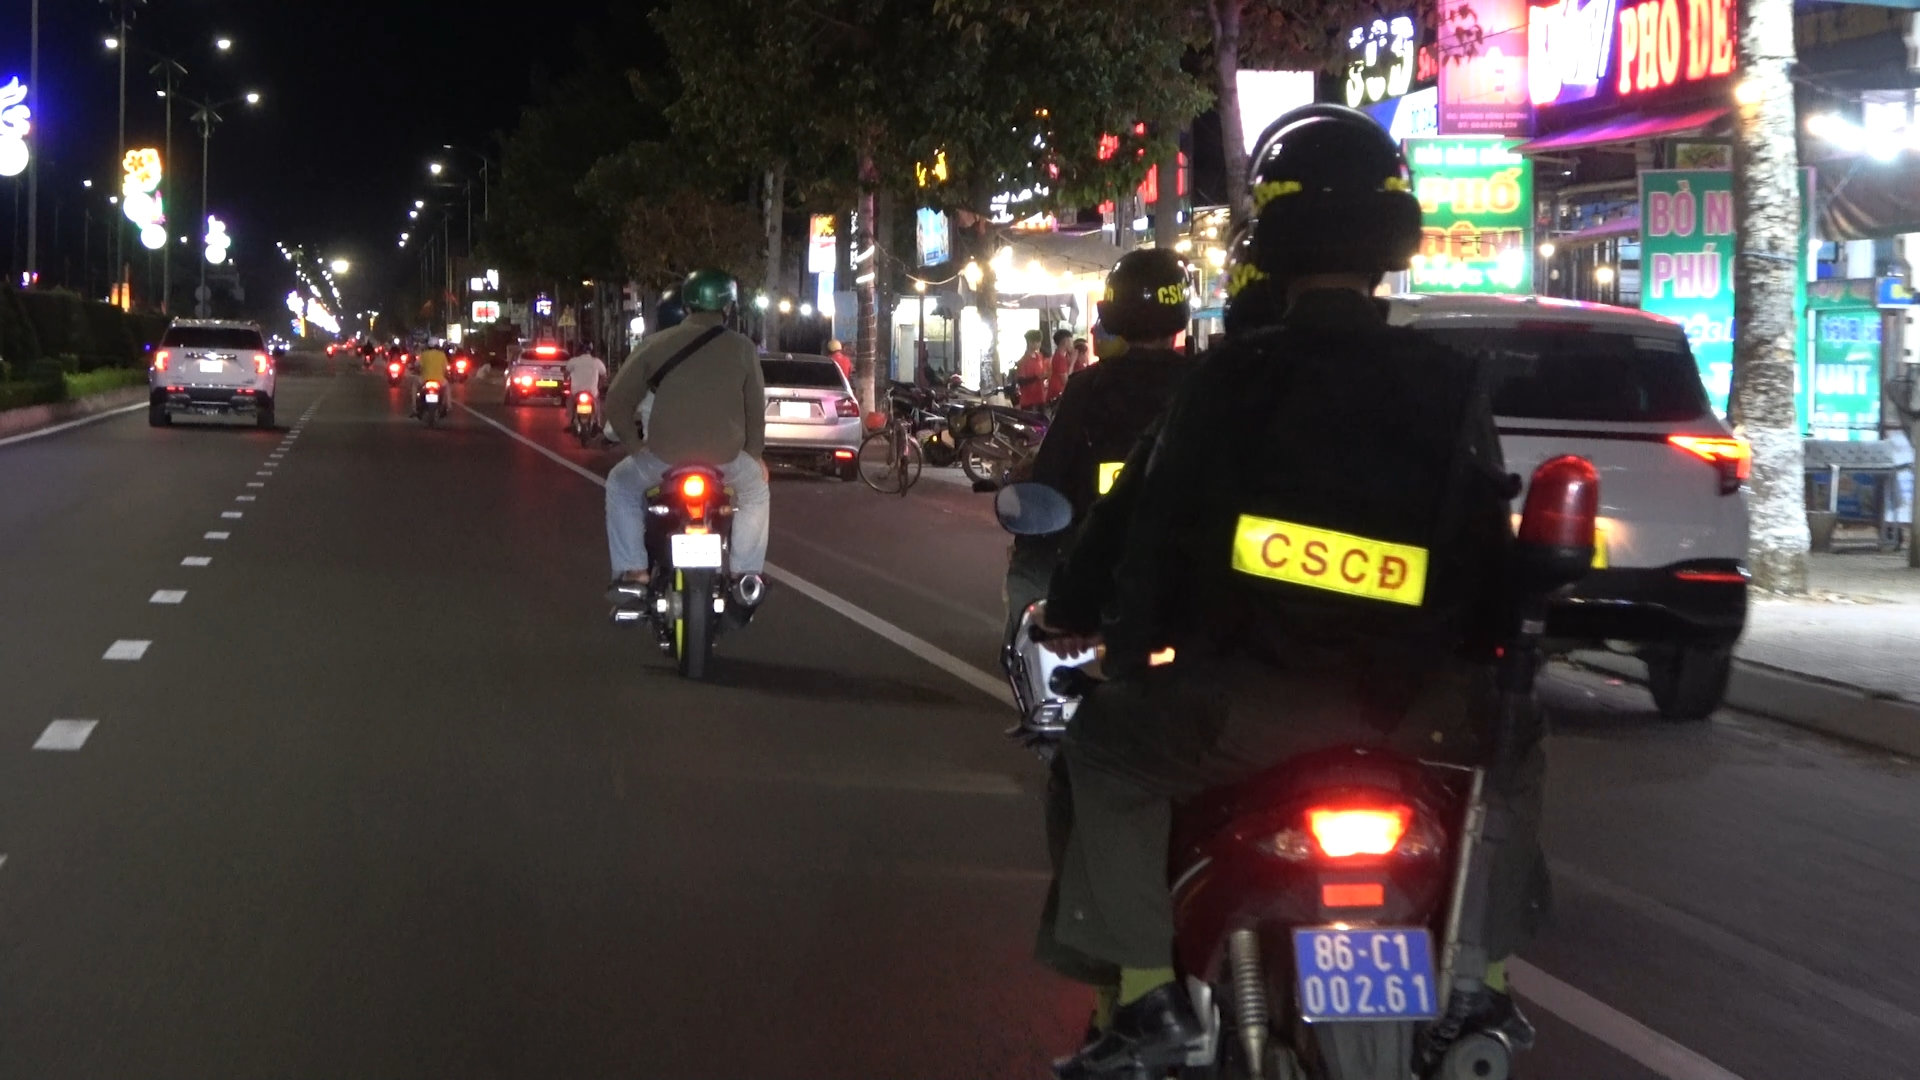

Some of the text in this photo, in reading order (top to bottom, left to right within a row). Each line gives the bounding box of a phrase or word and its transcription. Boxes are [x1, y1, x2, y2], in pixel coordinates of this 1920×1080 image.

[1648, 180, 1697, 237] BÒ
[1652, 243, 1721, 299] PHÚ
[1261, 532, 1408, 590] CSCĐ
[1313, 933, 1410, 972] 86-C1
[1304, 974, 1430, 1014] 002.61
